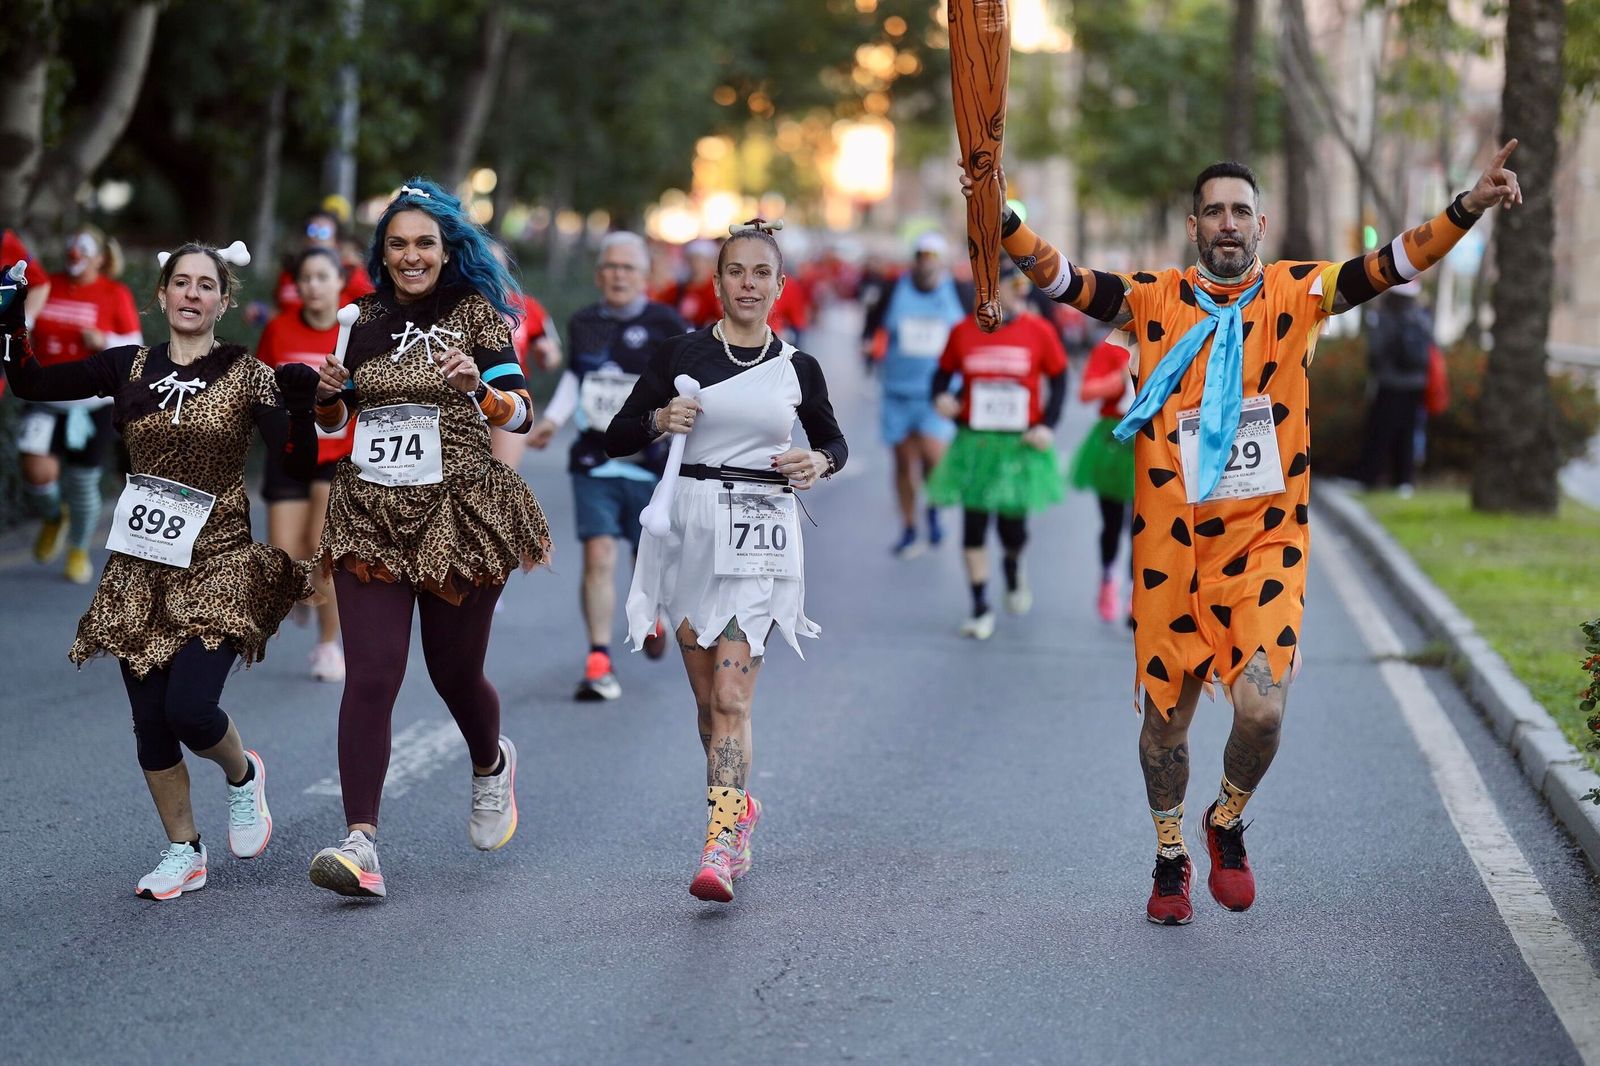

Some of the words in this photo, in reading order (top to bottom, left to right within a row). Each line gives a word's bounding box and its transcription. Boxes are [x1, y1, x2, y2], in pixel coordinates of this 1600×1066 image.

[368, 434, 424, 463] 574
[1224, 441, 1261, 472] 29
[128, 504, 186, 540] 898
[733, 523, 787, 551] 710
